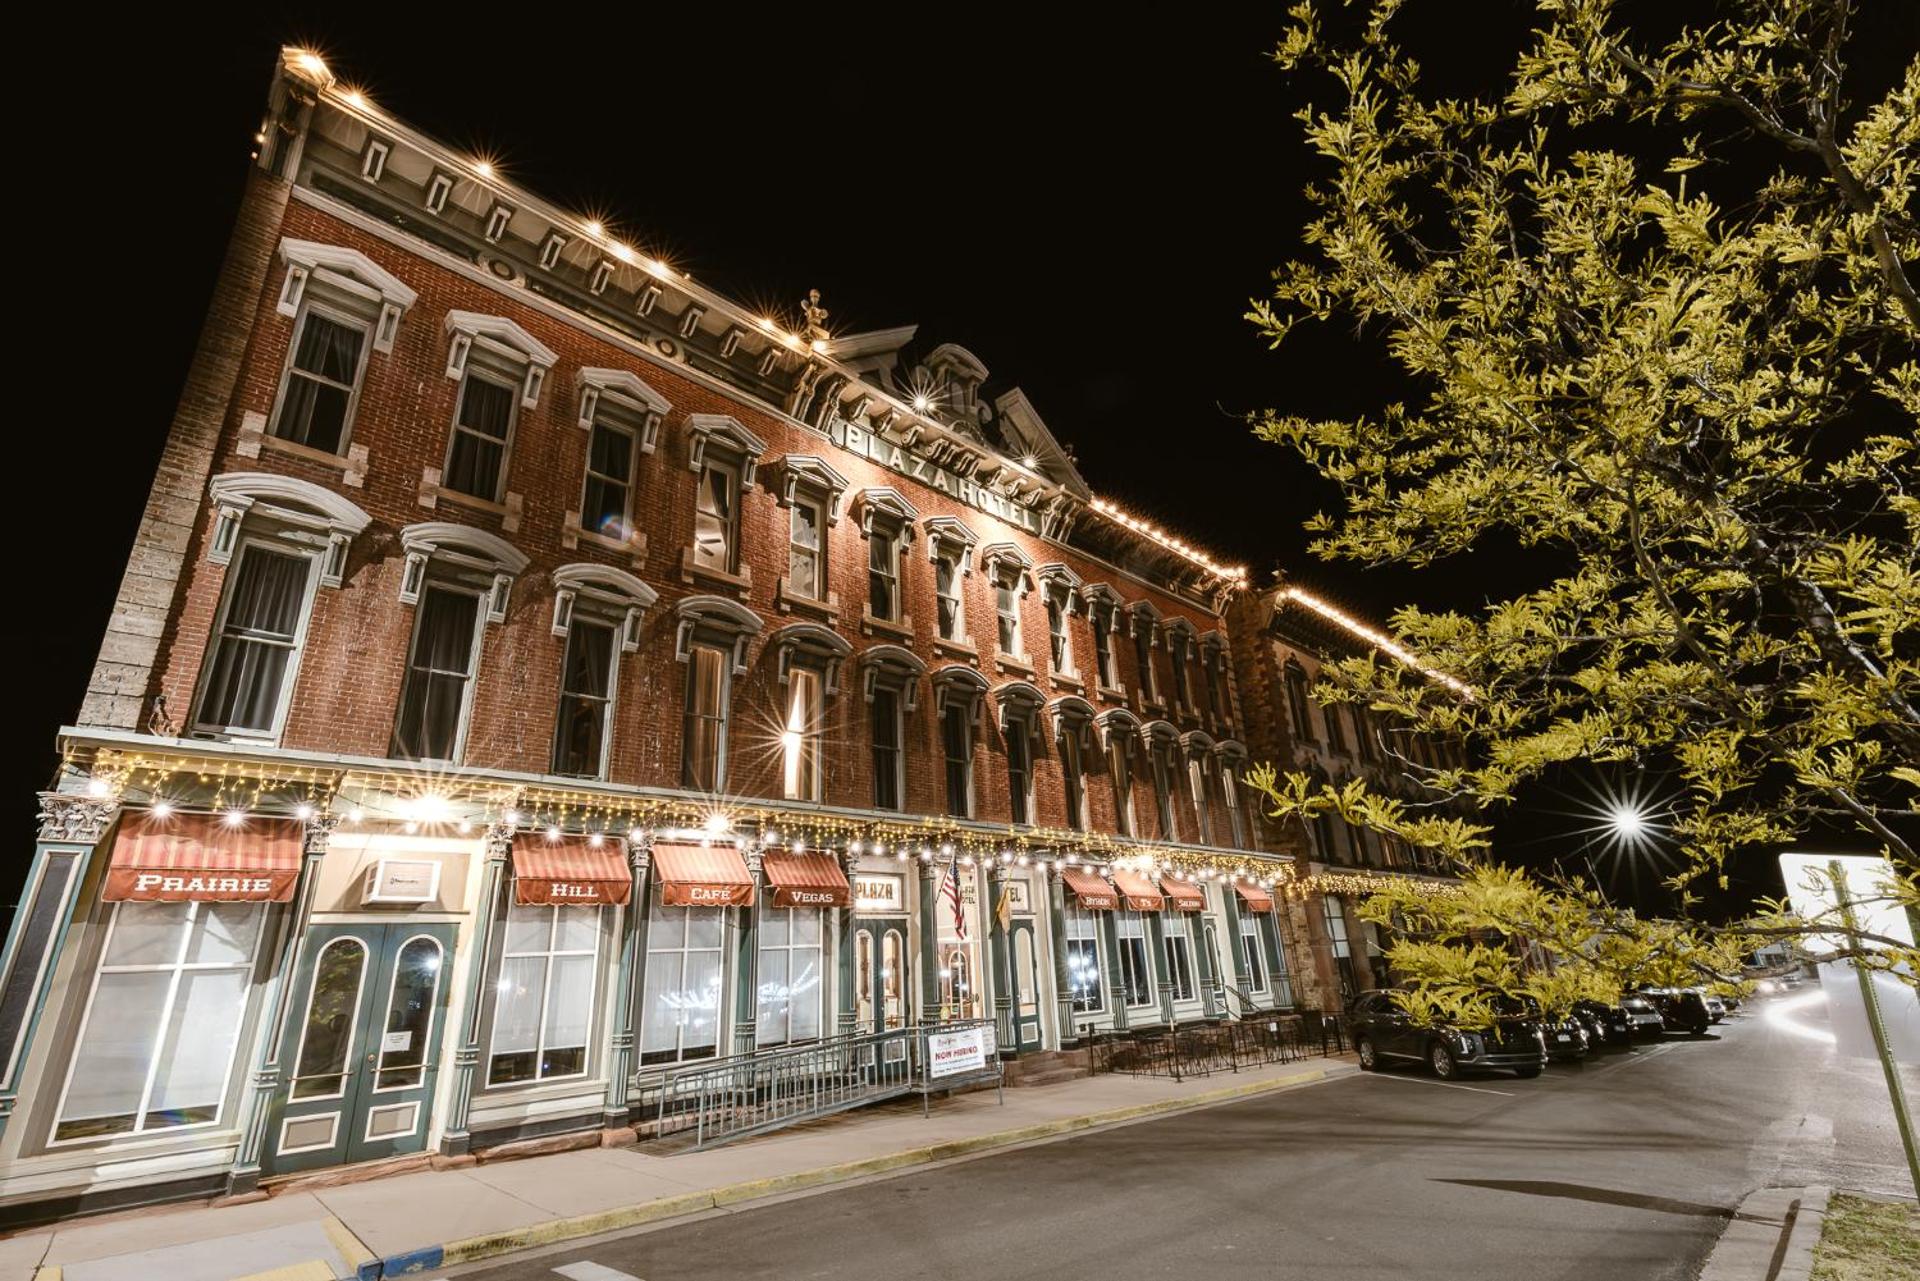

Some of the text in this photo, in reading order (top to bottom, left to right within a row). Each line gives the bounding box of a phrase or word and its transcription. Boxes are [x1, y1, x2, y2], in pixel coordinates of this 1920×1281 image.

[846, 427, 1036, 532] PLAZA HOTEL
[134, 873, 273, 893] PRAIRIE
[550, 883, 600, 898] HILL
[854, 881, 894, 900] PLAZA
[791, 891, 835, 904] VEGAS
